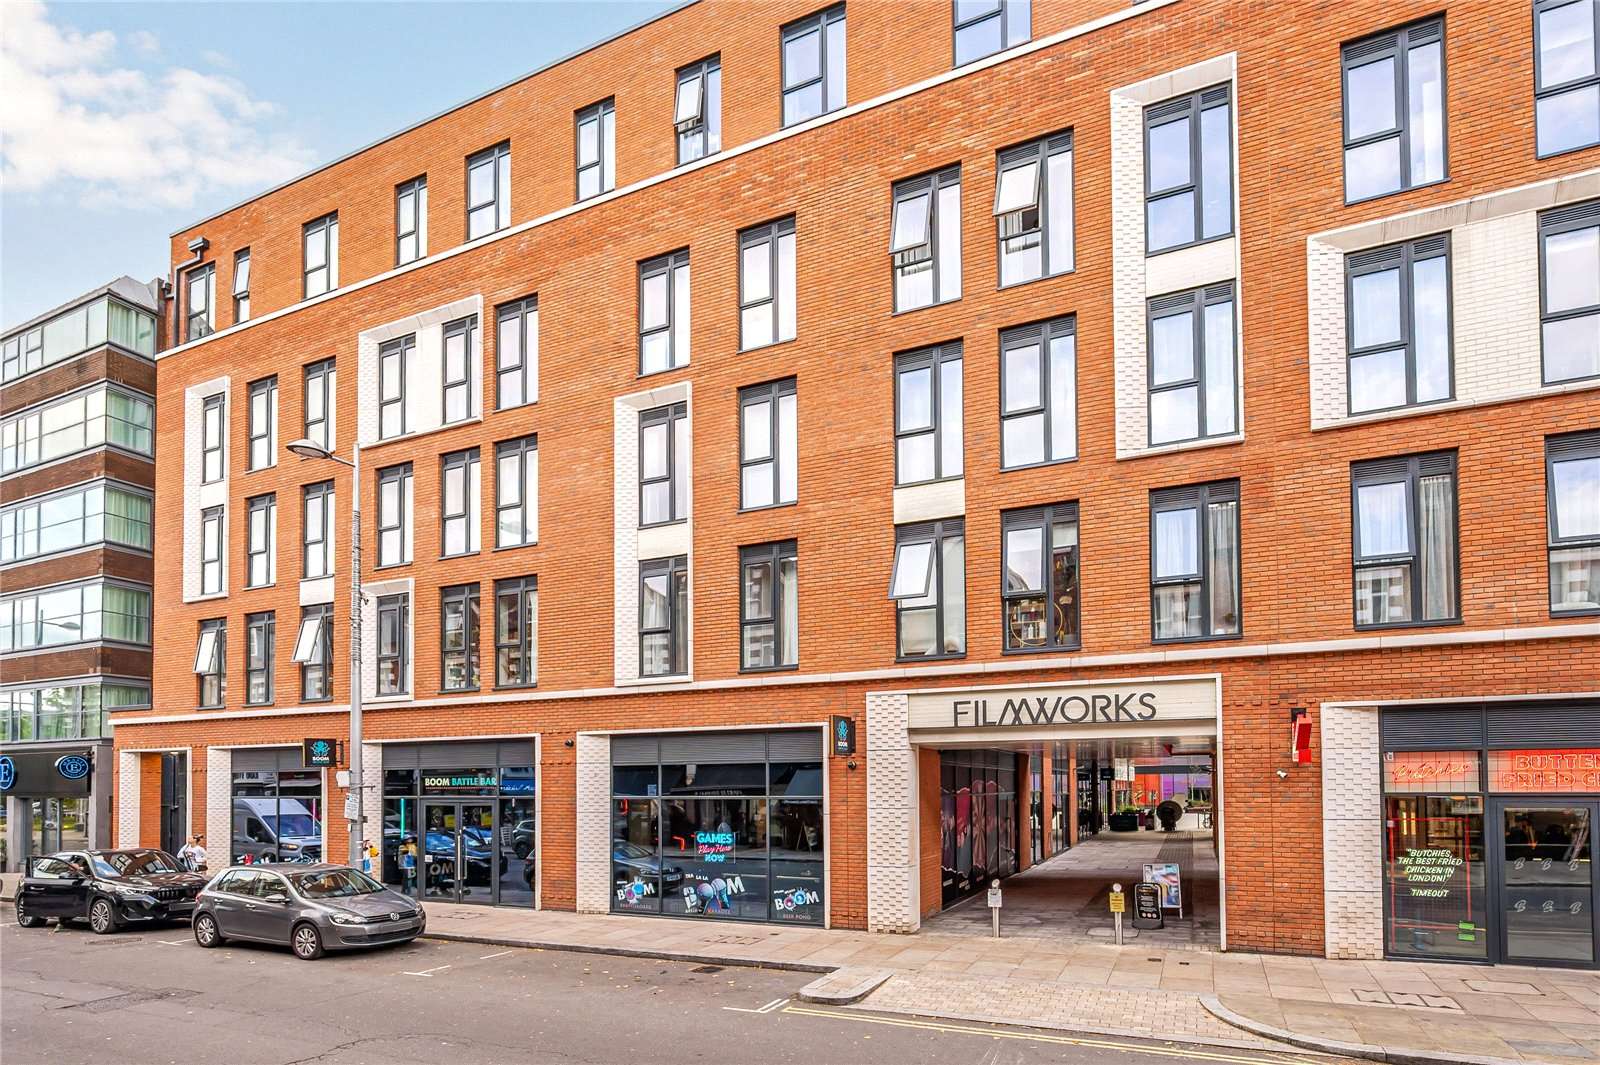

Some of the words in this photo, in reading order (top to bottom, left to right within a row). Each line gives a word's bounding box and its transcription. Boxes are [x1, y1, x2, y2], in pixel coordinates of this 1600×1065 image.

[953, 692, 1157, 727] FILMWORKS
[425, 778, 450, 786] BOOM
[451, 777, 479, 786] BATTLE
[480, 777, 497, 785] BAR
[1502, 772, 1576, 789] FRIED
[697, 833, 733, 843] GAMES
[704, 854, 726, 862] NOW
[1397, 857, 1413, 865] THE
[1415, 857, 1436, 865] BEST
[1437, 858, 1463, 866] FRIED
[1406, 866, 1443, 874] CHICKEN
[1445, 866, 1455, 874] IN
[1411, 888, 1449, 897] TIMEOUT
